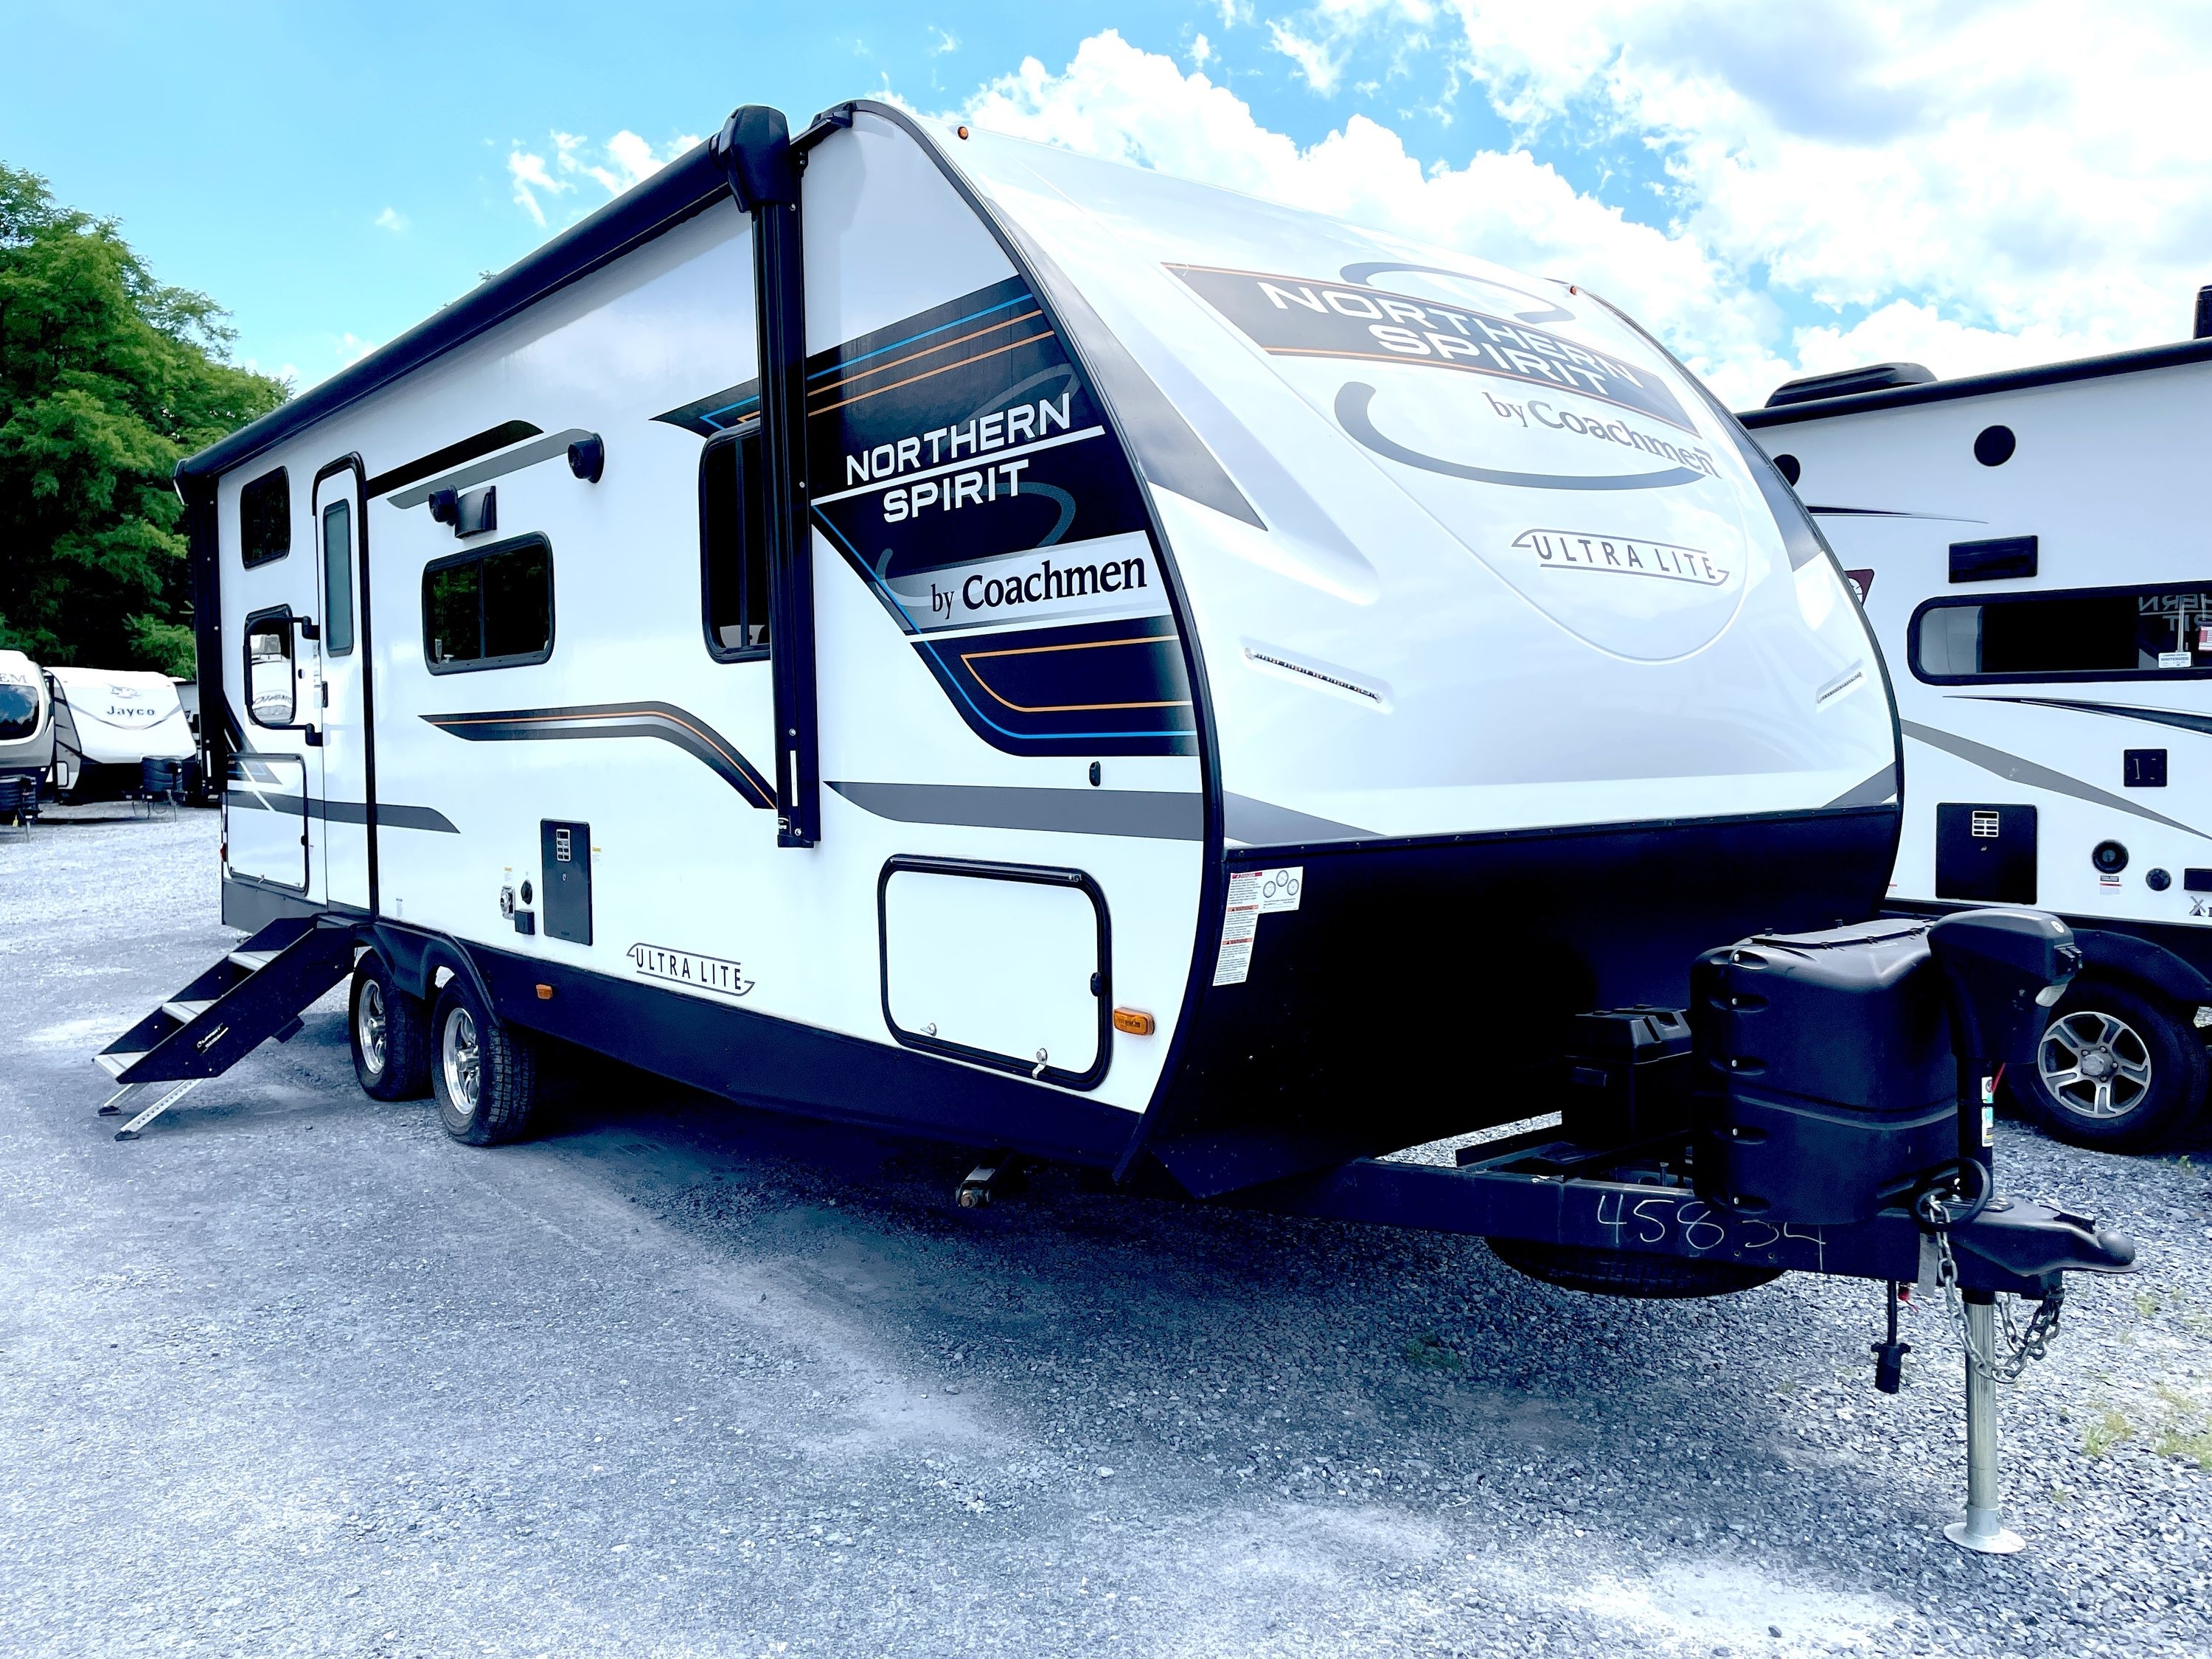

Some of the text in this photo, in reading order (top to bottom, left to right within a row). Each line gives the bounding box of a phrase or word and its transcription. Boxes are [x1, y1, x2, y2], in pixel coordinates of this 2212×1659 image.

[1257, 281, 1644, 389] NORTHERN
[1368, 324, 1611, 394] SPIRIT
[846, 393, 1071, 486] NORTHERN
[1481, 392, 1722, 479] by Coachmen
[883, 459, 1029, 524] SPIRIT
[931, 557, 1147, 620] by Coachmen
[1531, 535, 1717, 580] ULTRA LITE
[107, 706, 155, 718] Jayco
[636, 947, 741, 990] ULTRA LITE
